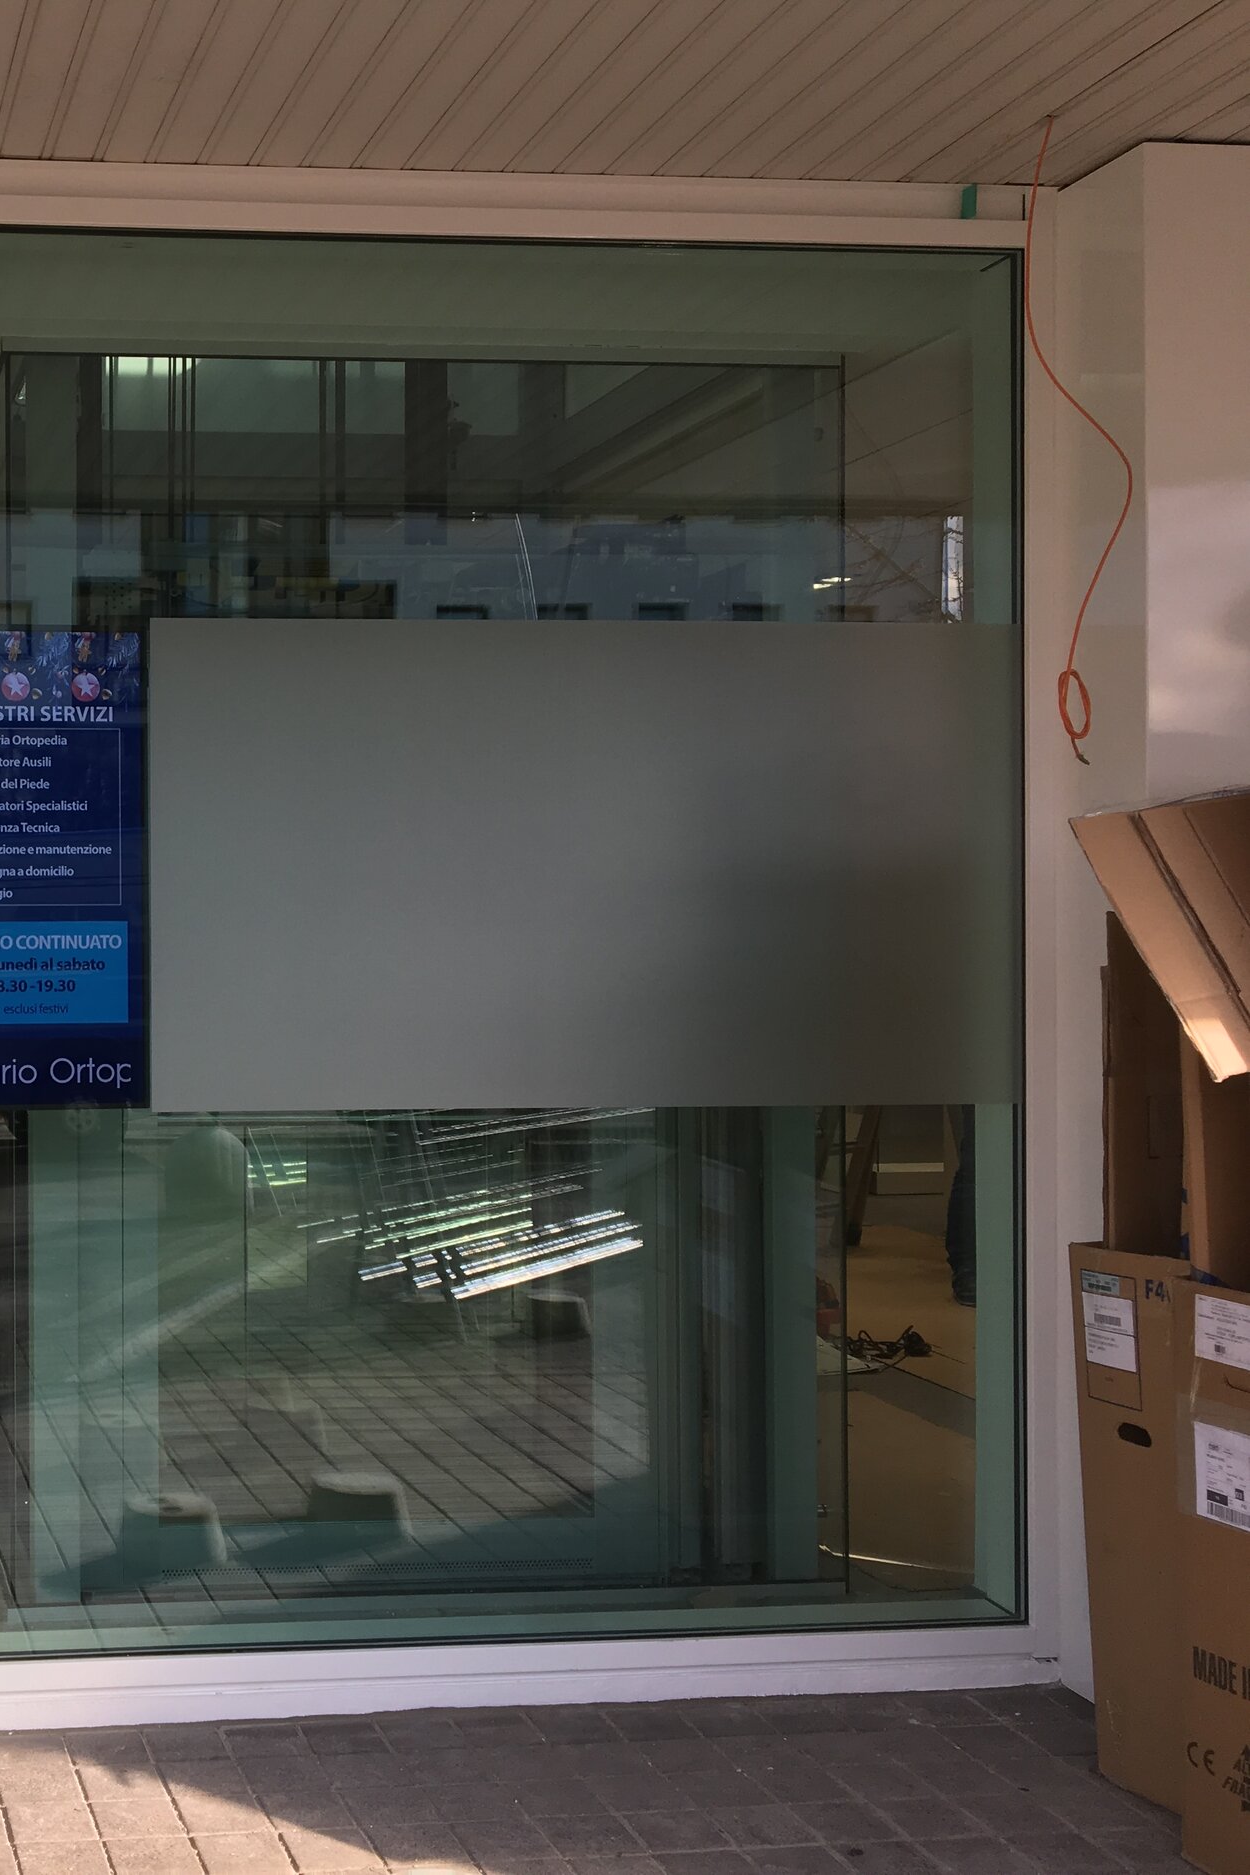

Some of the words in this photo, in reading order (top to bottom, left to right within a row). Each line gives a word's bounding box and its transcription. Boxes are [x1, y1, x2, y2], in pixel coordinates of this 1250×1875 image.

[41, 706, 114, 723] SERVIZI
[12, 735, 67, 748] Ortopedia
[22, 757, 52, 768] Ausili
[1, 778, 17, 789] del
[20, 778, 50, 789] Piede
[26, 800, 88, 813] Specialistici
[21, 822, 60, 833] Tecnica
[28, 847, 34, 855] e
[36, 844, 112, 855] manutenzione
[18, 869, 24, 877] a
[26, 866, 74, 877] domicilio
[16, 934, 122, 950] CONTINUATO
[41, 957, 52, 970] al
[56, 957, 106, 970] sabato
[3, 1003, 37, 1014] esclusi
[39, 1003, 68, 1014] festivi
[1192, 1646, 1237, 1695] MADE
